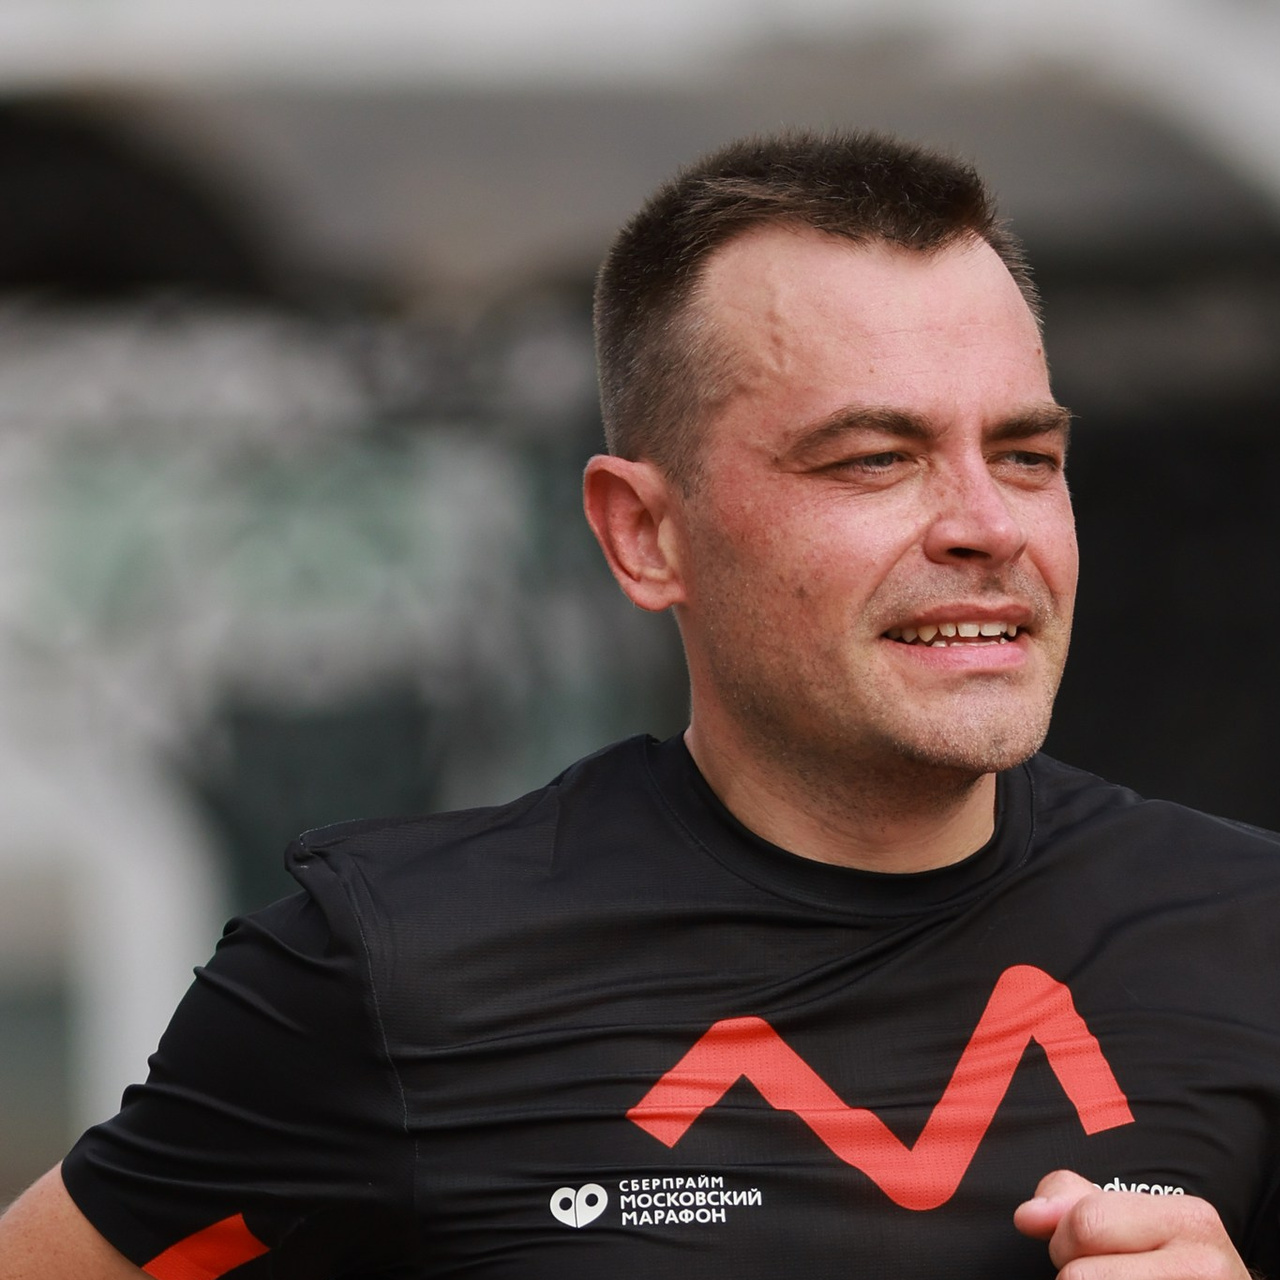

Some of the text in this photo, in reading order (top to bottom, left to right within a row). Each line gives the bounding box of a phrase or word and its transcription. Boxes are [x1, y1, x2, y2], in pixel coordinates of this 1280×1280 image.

[619, 1175, 723, 1192] СБЕРПРАЙМ
[620, 1188, 762, 1210] МОСКОВСКИЙ
[621, 1208, 726, 1226] МАРАФОН
